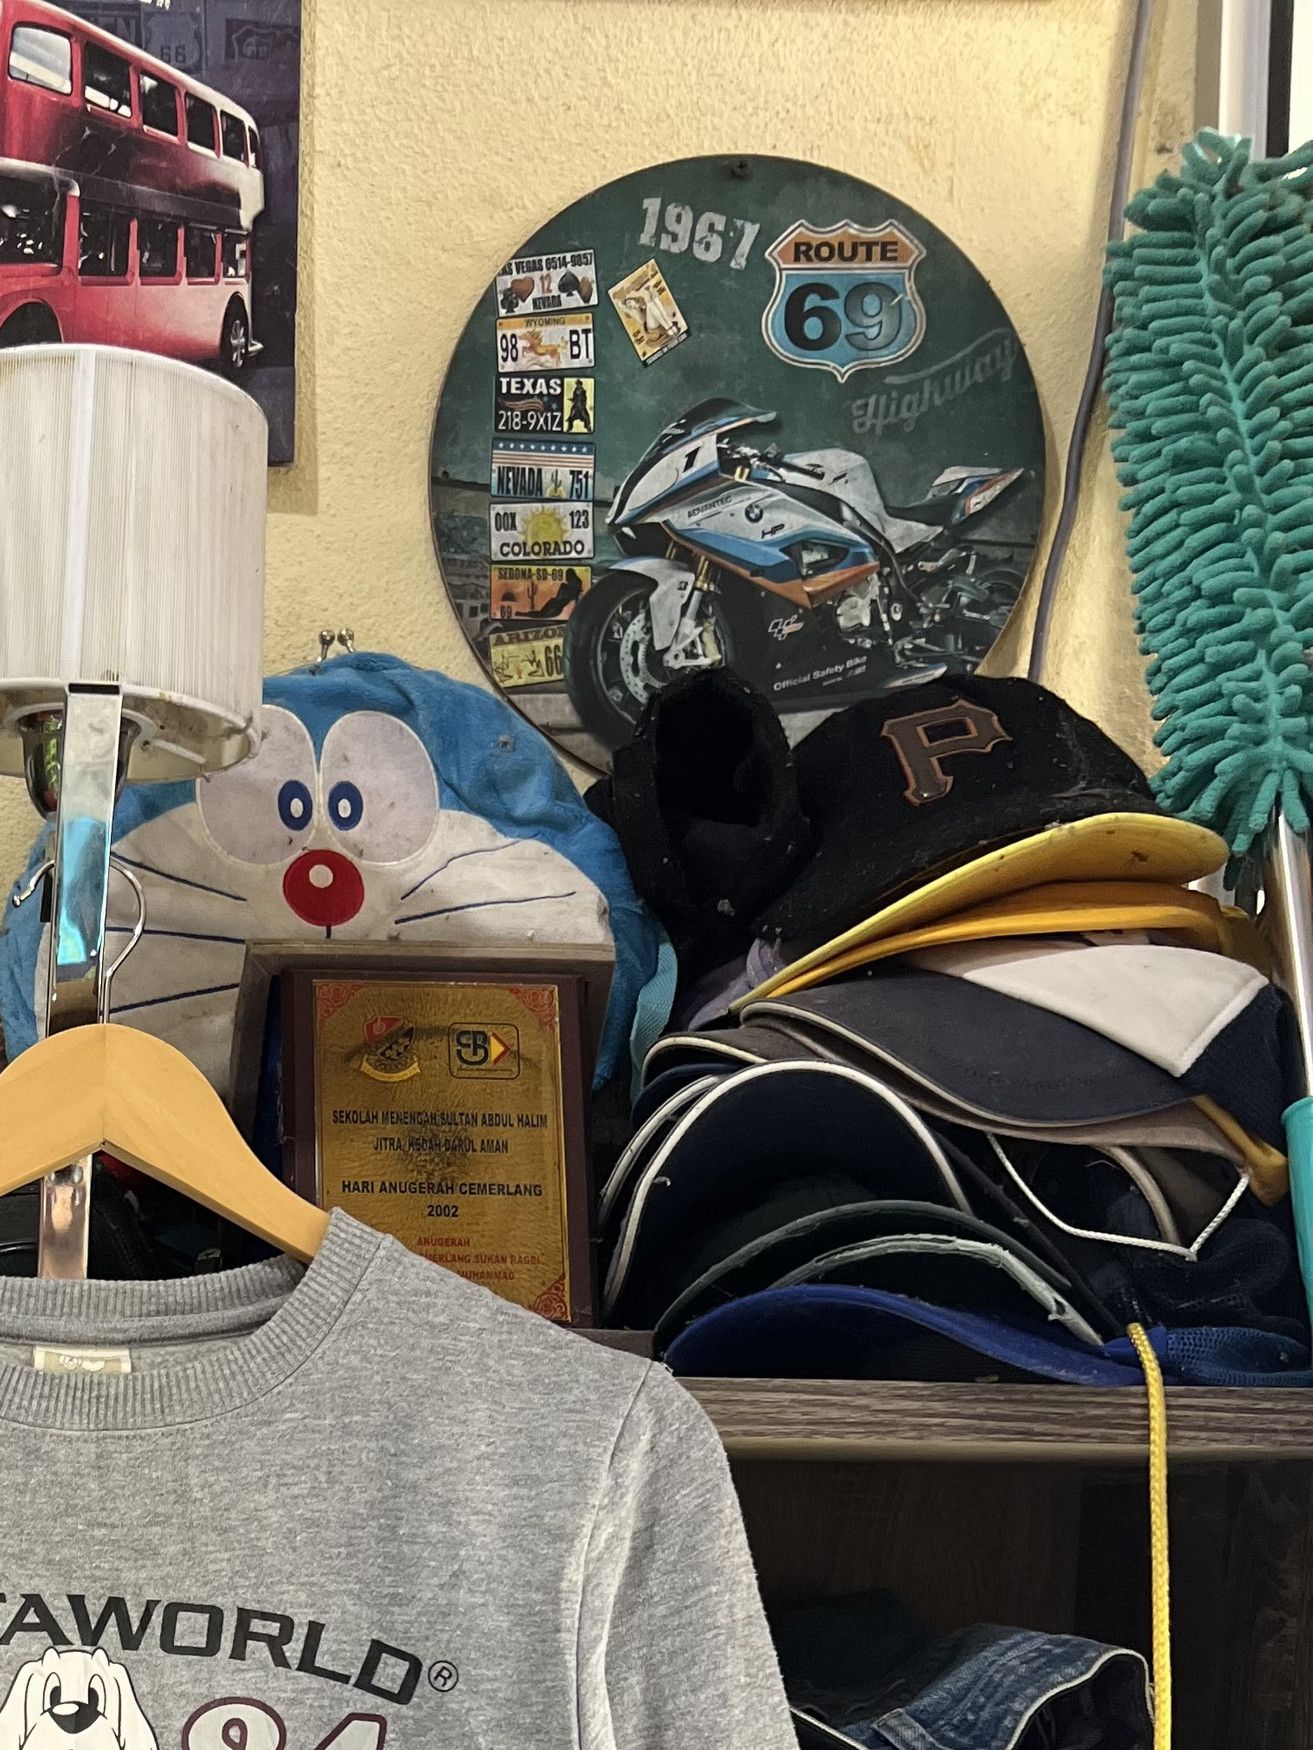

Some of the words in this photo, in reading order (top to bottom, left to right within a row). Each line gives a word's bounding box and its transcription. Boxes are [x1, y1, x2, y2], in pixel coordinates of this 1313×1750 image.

[638, 197, 761, 270] 1967
[793, 241, 899, 263] ROUTE
[515, 258, 543, 275] VEGAS
[532, 294, 562, 310] NEVADA
[524, 316, 566, 328] WYOMING
[785, 281, 903, 352] 69
[500, 333, 519, 363] 98
[569, 328, 593, 361] BT
[499, 377, 562, 395] TEXAS
[852, 330, 1020, 434] Highway
[683, 446, 702, 473] 1
[497, 466, 543, 497] NEVADA
[569, 469, 590, 500] 751
[688, 495, 733, 518] ADVANTEC
[569, 509, 590, 529] 123
[499, 540, 585, 557] COLORADO
[544, 644, 563, 677] 66
[773, 674, 811, 691] Official
[812, 664, 845, 680] Safety
[881, 699, 1013, 807] P
[332, 1110, 378, 1125] SEKOLAH
[382, 1111, 437, 1127] MENENGAH
[440, 1112, 478, 1127] SULTAN
[481, 1113, 514, 1128] ABDUL
[517, 1114, 548, 1129] HALIM
[408, 1137, 441, 1152] KEDAH
[444, 1138, 476, 1153] DARUL
[479, 1139, 509, 1154] AMAN
[342, 1180, 375, 1194] HARI
[379, 1181, 454, 1195] ANUGERAH
[459, 1183, 543, 1197] CEMERLANG
[427, 1204, 459, 1218] 2002
[416, 1237, 471, 1247] ANUGERAH
[474, 1254, 507, 1264] SUKAN
